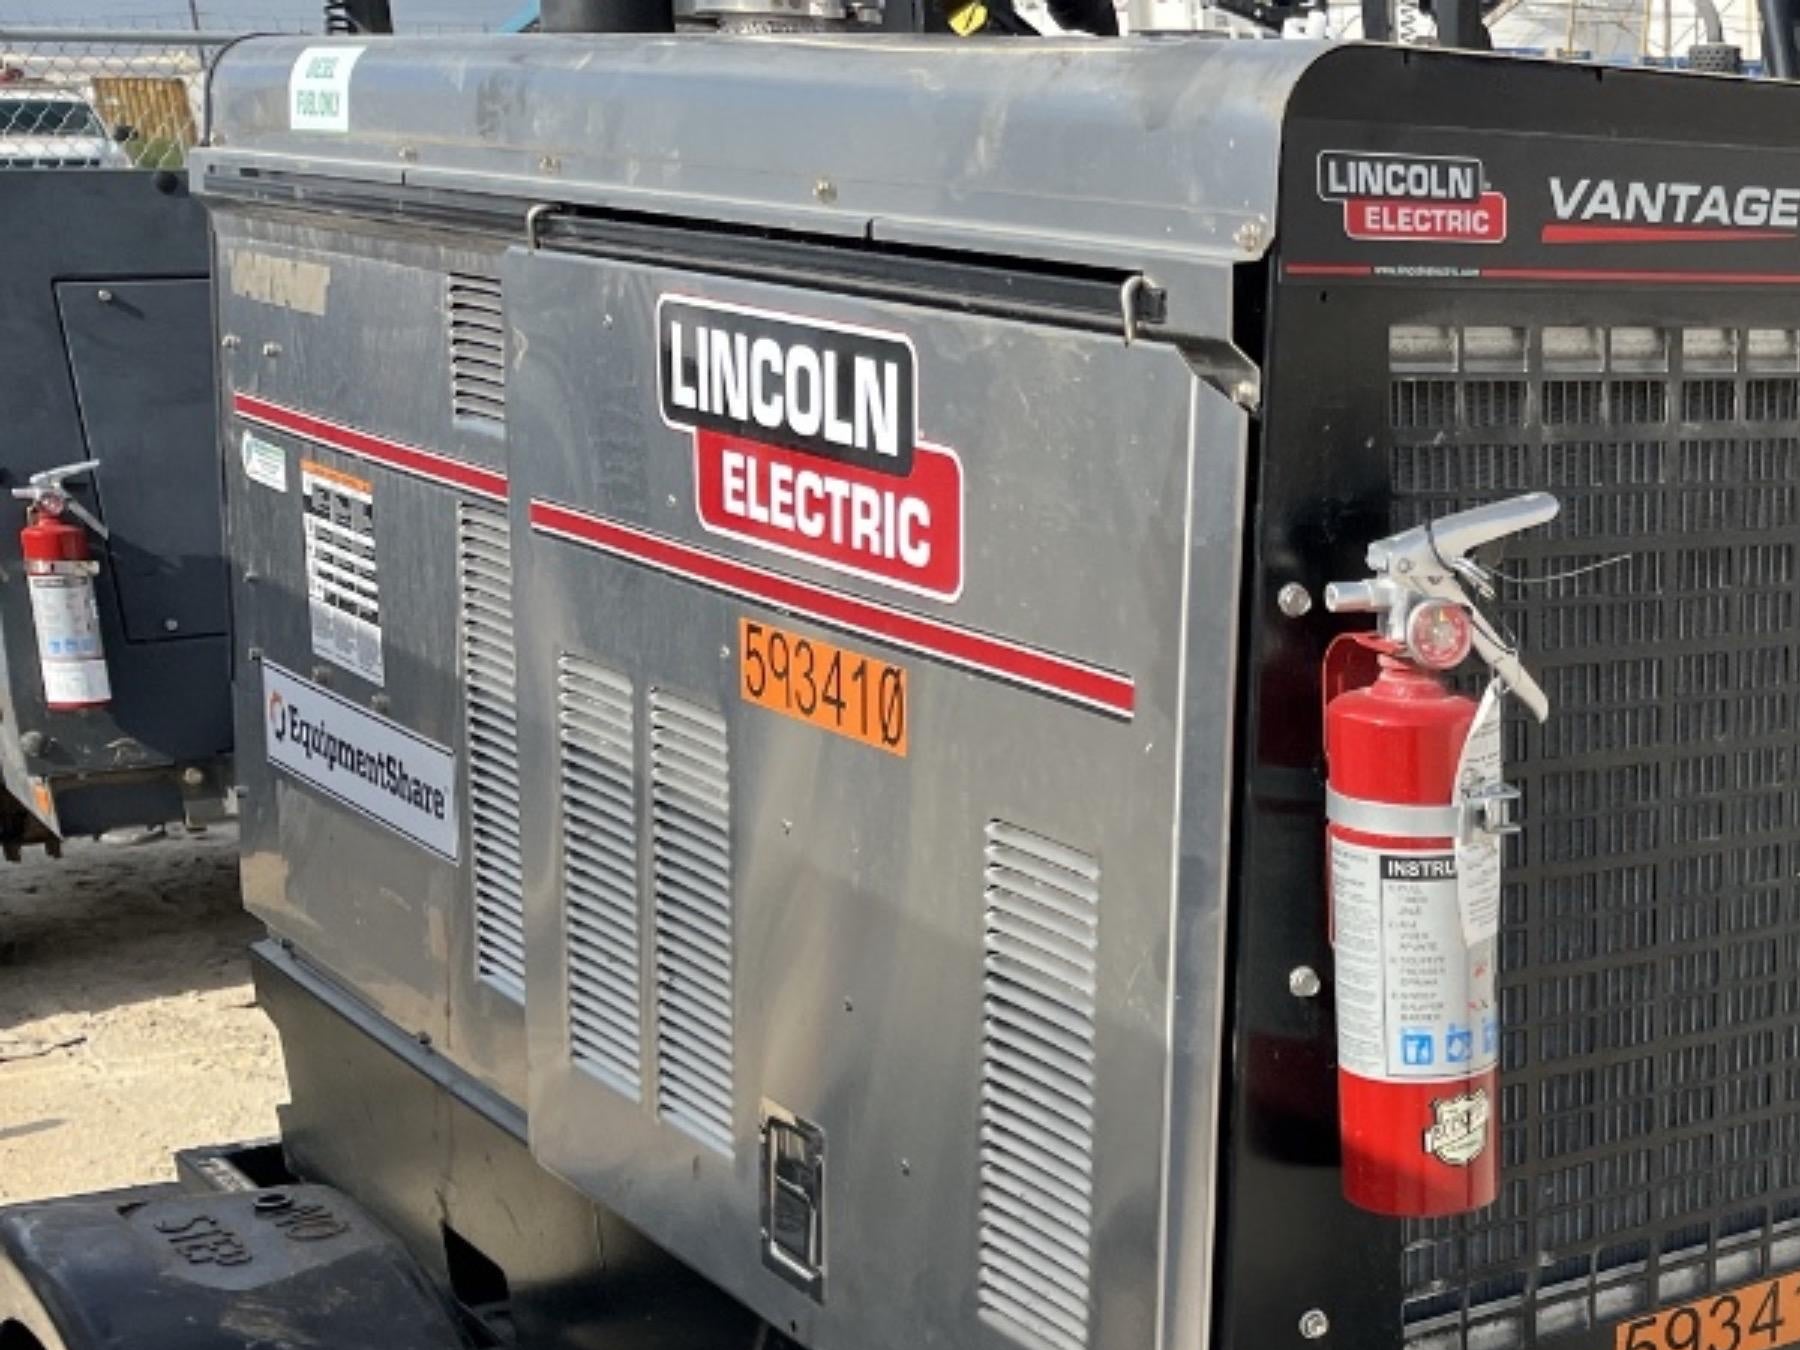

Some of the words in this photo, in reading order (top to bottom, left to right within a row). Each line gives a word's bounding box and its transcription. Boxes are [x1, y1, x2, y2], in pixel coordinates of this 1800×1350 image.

[1328, 161, 1474, 200] LINCOLN
[1364, 205, 1490, 235] ELECTRIC
[1549, 177, 1800, 227] VANTAGE
[671, 320, 898, 457] LINCOLN
[722, 450, 930, 567] ELECTRIC
[746, 624, 904, 745] 593410
[288, 704, 445, 820] EquipmentShare
[1388, 860, 1456, 877] INSTRU
